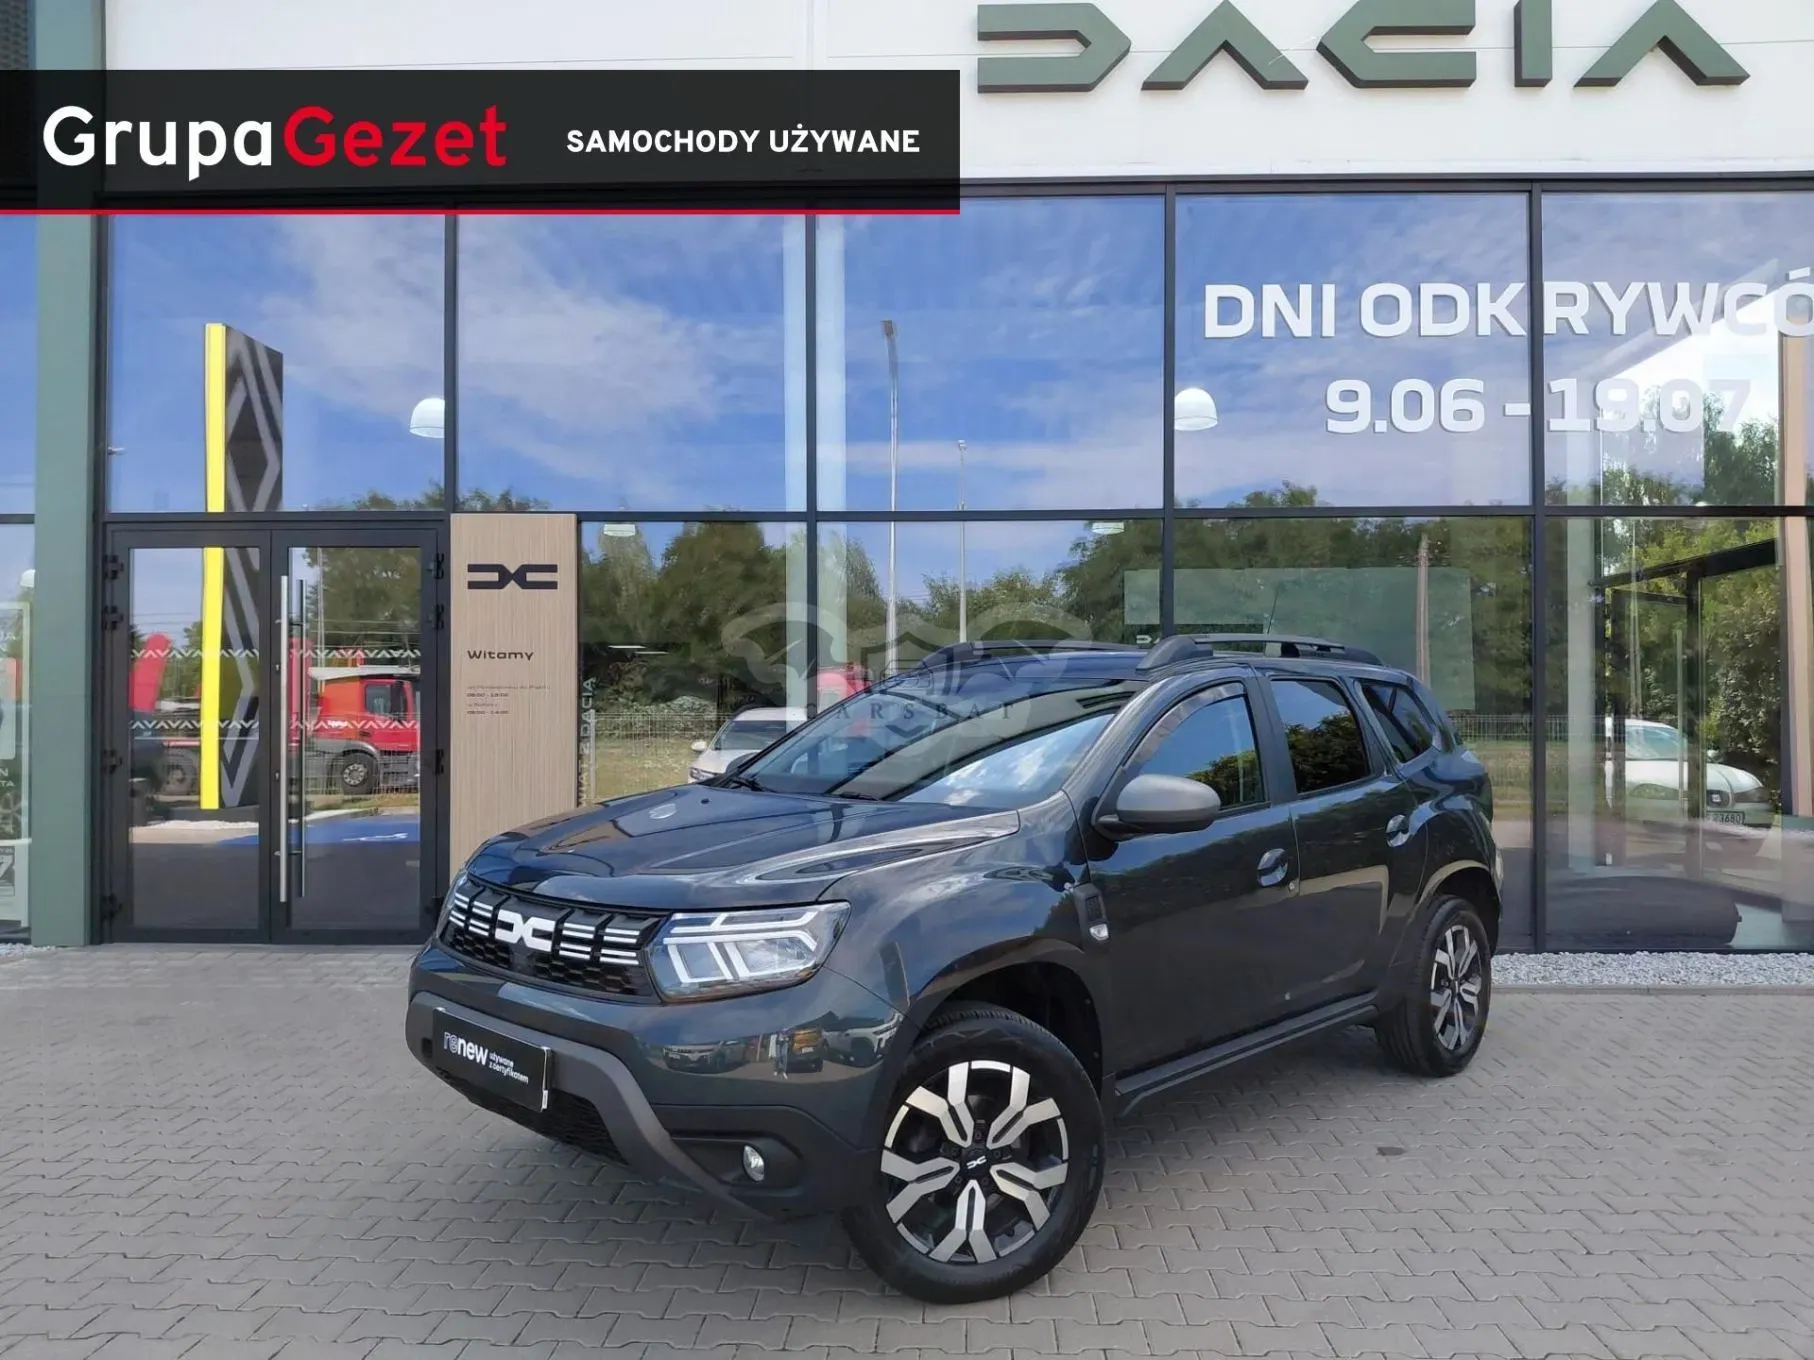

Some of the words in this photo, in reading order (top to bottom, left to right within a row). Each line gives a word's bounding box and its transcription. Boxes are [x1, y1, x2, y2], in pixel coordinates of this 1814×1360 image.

[977, 0, 1750, 93] DACIA
[1204, 283, 1337, 339] DNI
[1325, 378, 1486, 434] 9.06
[1549, 377, 1752, 433] 19.07
[467, 650, 534, 661] Witamy
[580, 677, 596, 737] DACIA
[443, 1031, 489, 1066] renew
